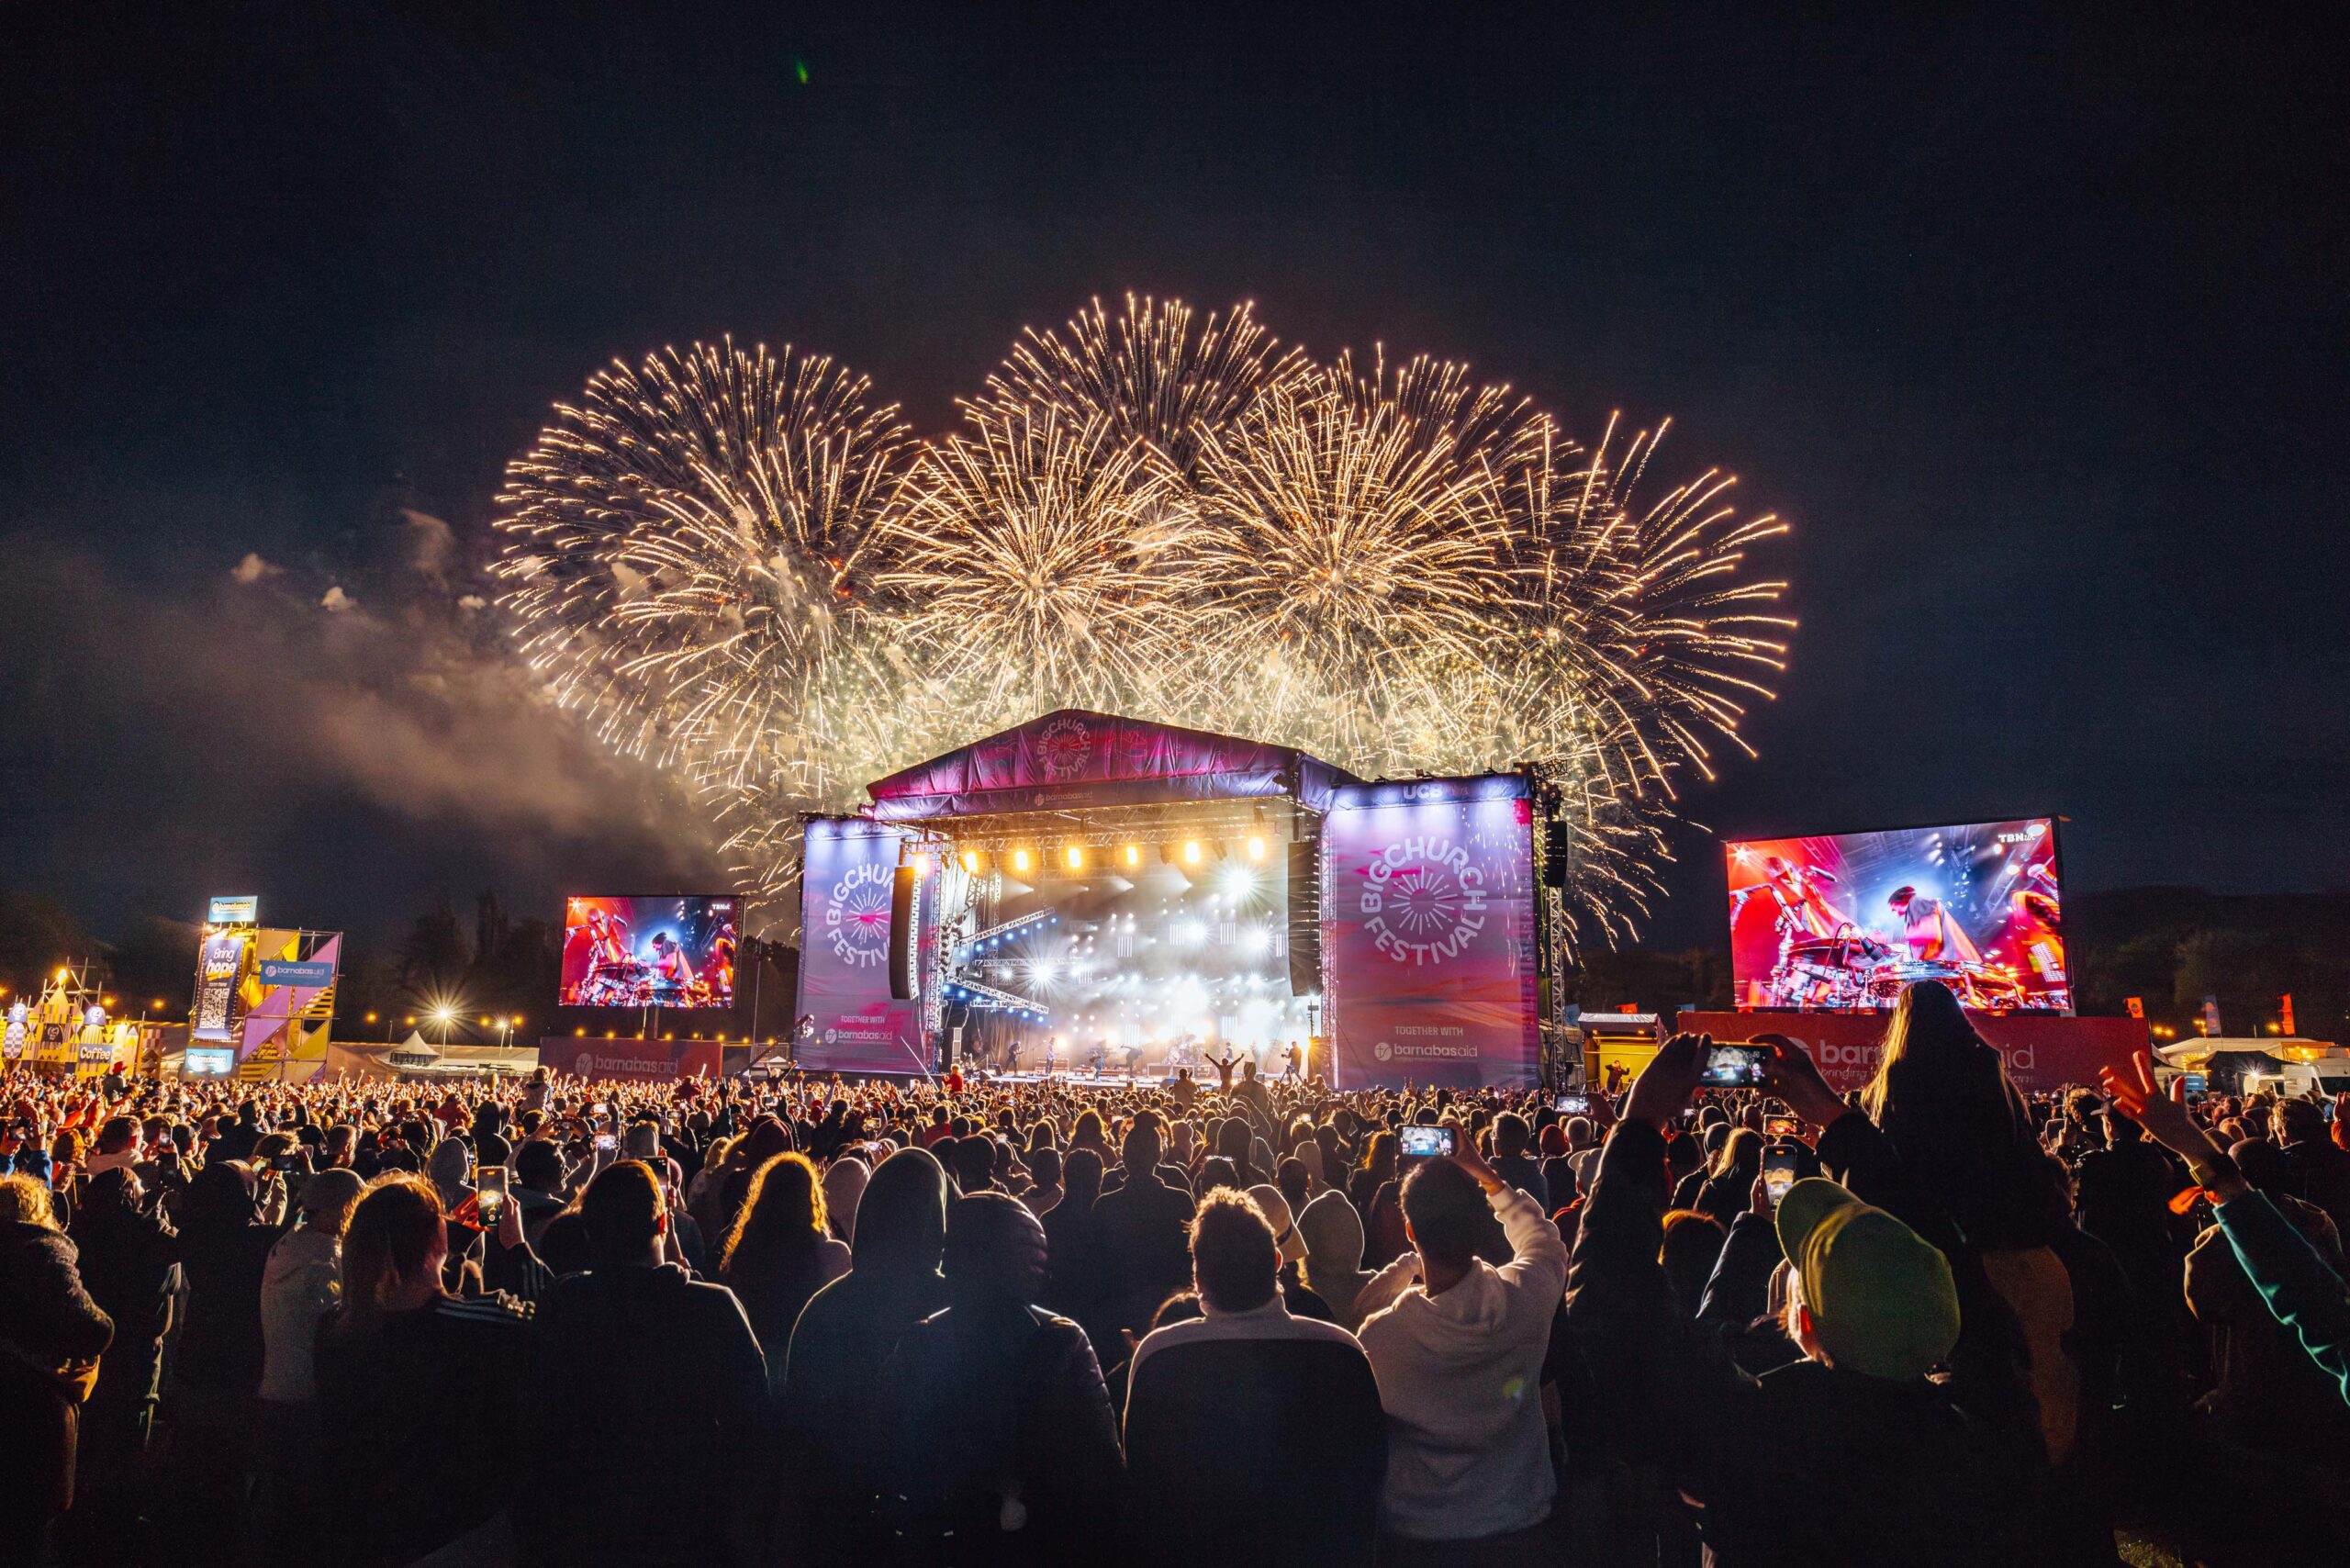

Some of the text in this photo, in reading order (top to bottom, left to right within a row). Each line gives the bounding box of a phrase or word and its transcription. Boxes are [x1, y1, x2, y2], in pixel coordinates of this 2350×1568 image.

[1403, 784, 1444, 800] UCB
[826, 863, 895, 925] BIGCHUR
[828, 927, 890, 968] FESTIV
[1364, 916, 1485, 966] FESTIVAL
[213, 947, 235, 962] Bring
[206, 959, 236, 979] hope
[841, 1014, 885, 1024] TOGETHER WITH
[1395, 1026, 1464, 1036] TOGETHER WITH
[80, 1047, 110, 1060] Coffee
